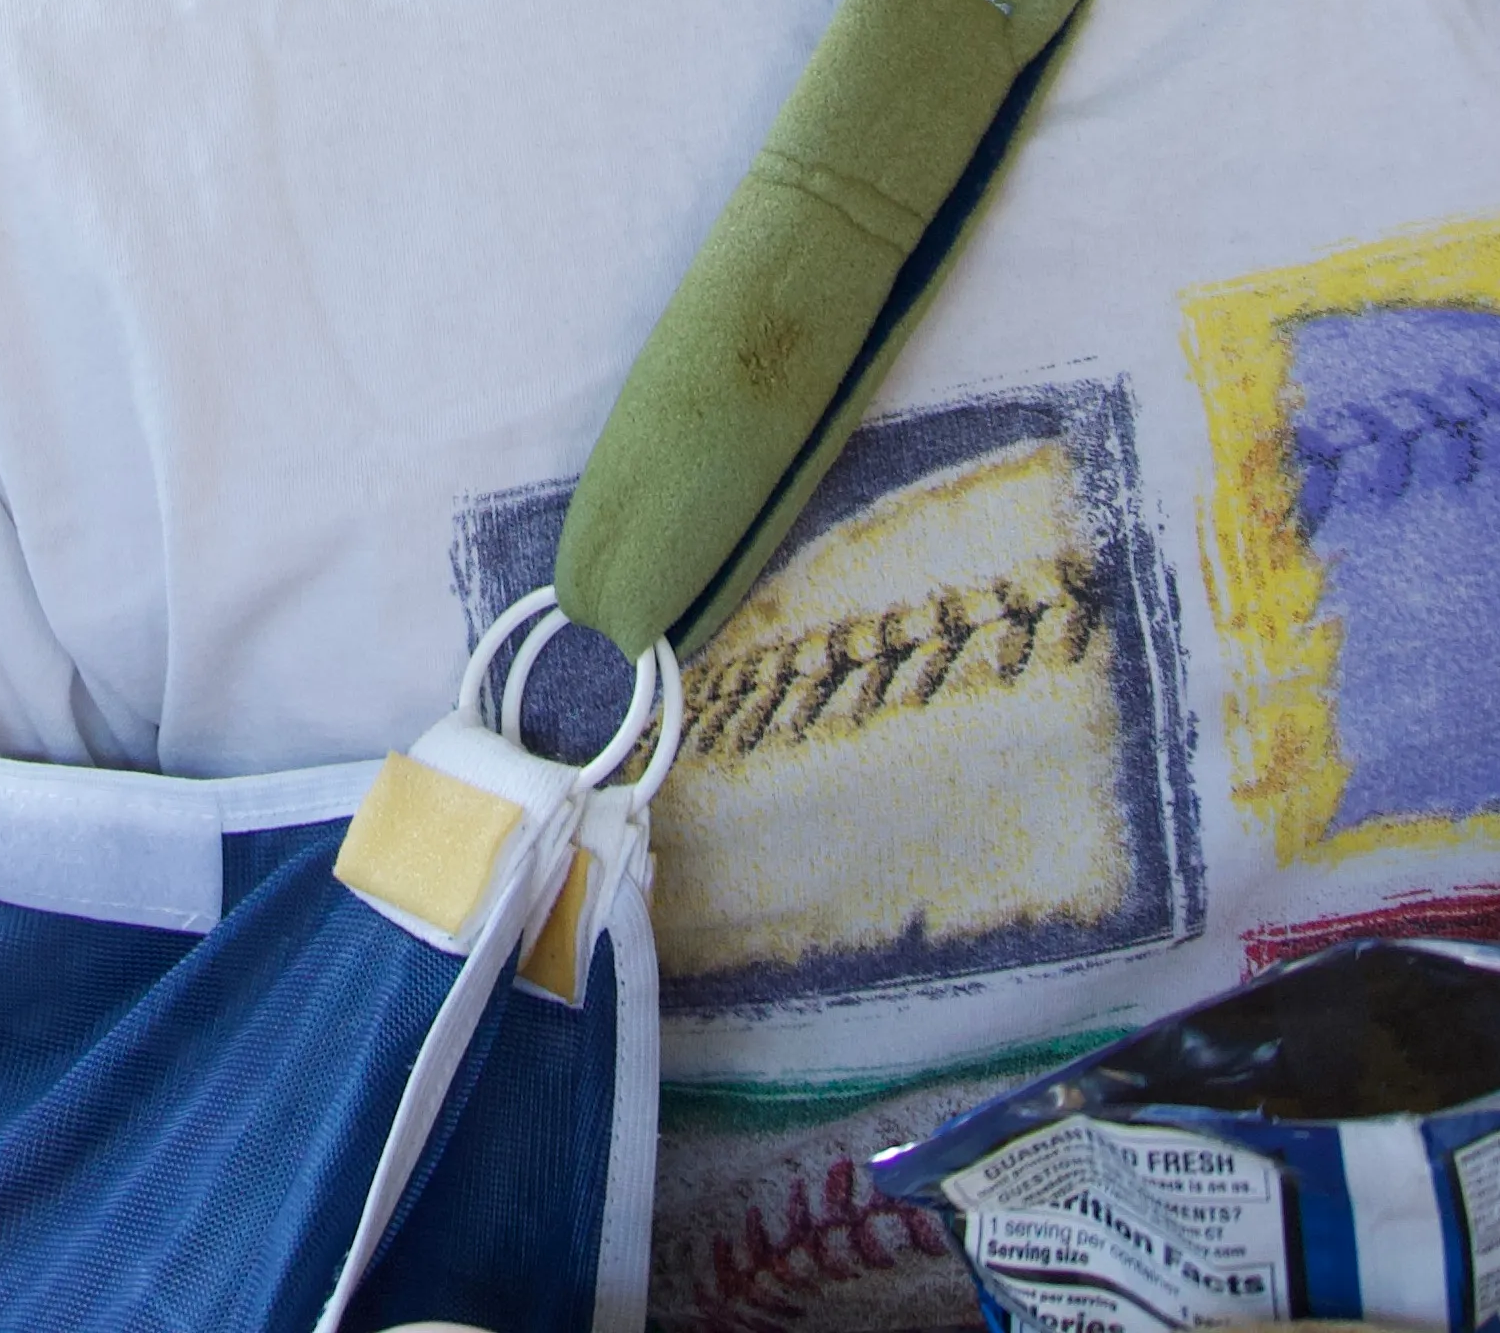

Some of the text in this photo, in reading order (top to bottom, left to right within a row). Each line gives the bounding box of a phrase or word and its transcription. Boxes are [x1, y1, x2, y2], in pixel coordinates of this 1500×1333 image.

[1147, 1149, 1235, 1176] FRESH
[1003, 1217, 1072, 1245] serving
[1076, 1230, 1106, 1250] per
[986, 1238, 1091, 1265] Serving size
[1163, 1241, 1265, 1296] Facts
[1067, 1293, 1119, 1313] serving
